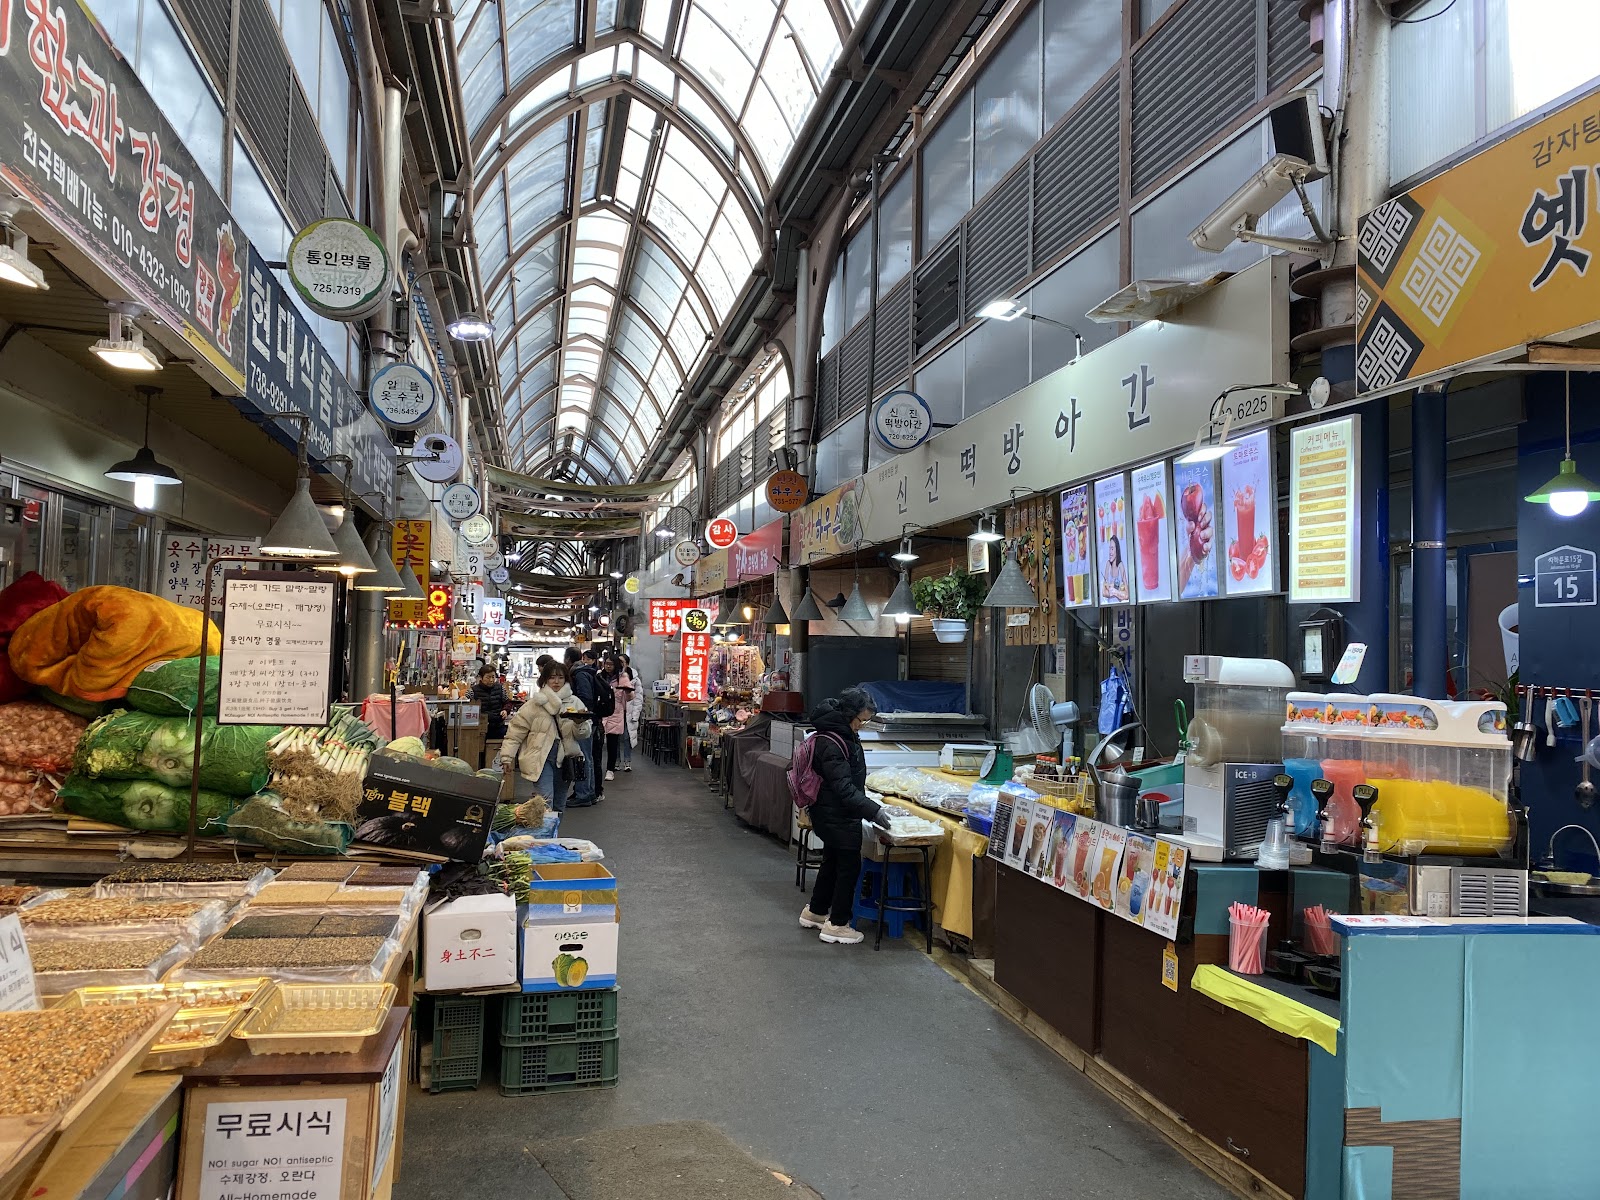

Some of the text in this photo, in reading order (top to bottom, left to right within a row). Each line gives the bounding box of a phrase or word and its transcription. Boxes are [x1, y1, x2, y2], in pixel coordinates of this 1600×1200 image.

[129, 127, 194, 270] 강정
[1518, 163, 1600, 292] 옛
[112, 215, 191, 316] 010-4323-1902
[306, 250, 372, 270] 통인명물
[313, 283, 361, 296] 725.7319
[250, 266, 333, 429] 현대식품
[381, 390, 424, 404] 옷수선
[890, 408, 917, 419] 신진
[885, 418, 922, 430] 떡방아간
[1307, 430, 1339, 445] 커피메뉴
[772, 486, 803, 497] 하우스
[712, 524, 733, 535] 감사
[468, 555, 479, 575] のり
[230, 583, 258, 592] 우주에
[263, 584, 280, 592] 가도
[1553, 575, 1579, 599] 15
[652, 619, 664, 632] 원조
[687, 616, 705, 628] 달인
[229, 635, 261, 645] 통인시장
[266, 636, 281, 646] 명물
[485, 628, 507, 643] 식당
[685, 647, 706, 656] 할머니
[687, 657, 703, 700] 기름떡볶이
[388, 790, 432, 817] 블랙
[440, 948, 496, 963] 身土不二
[216, 1111, 331, 1139] 무료시식
[208, 1155, 334, 1169] NO! sugar NO! antiseptic
[279, 1170, 316, 1182] 오란다
